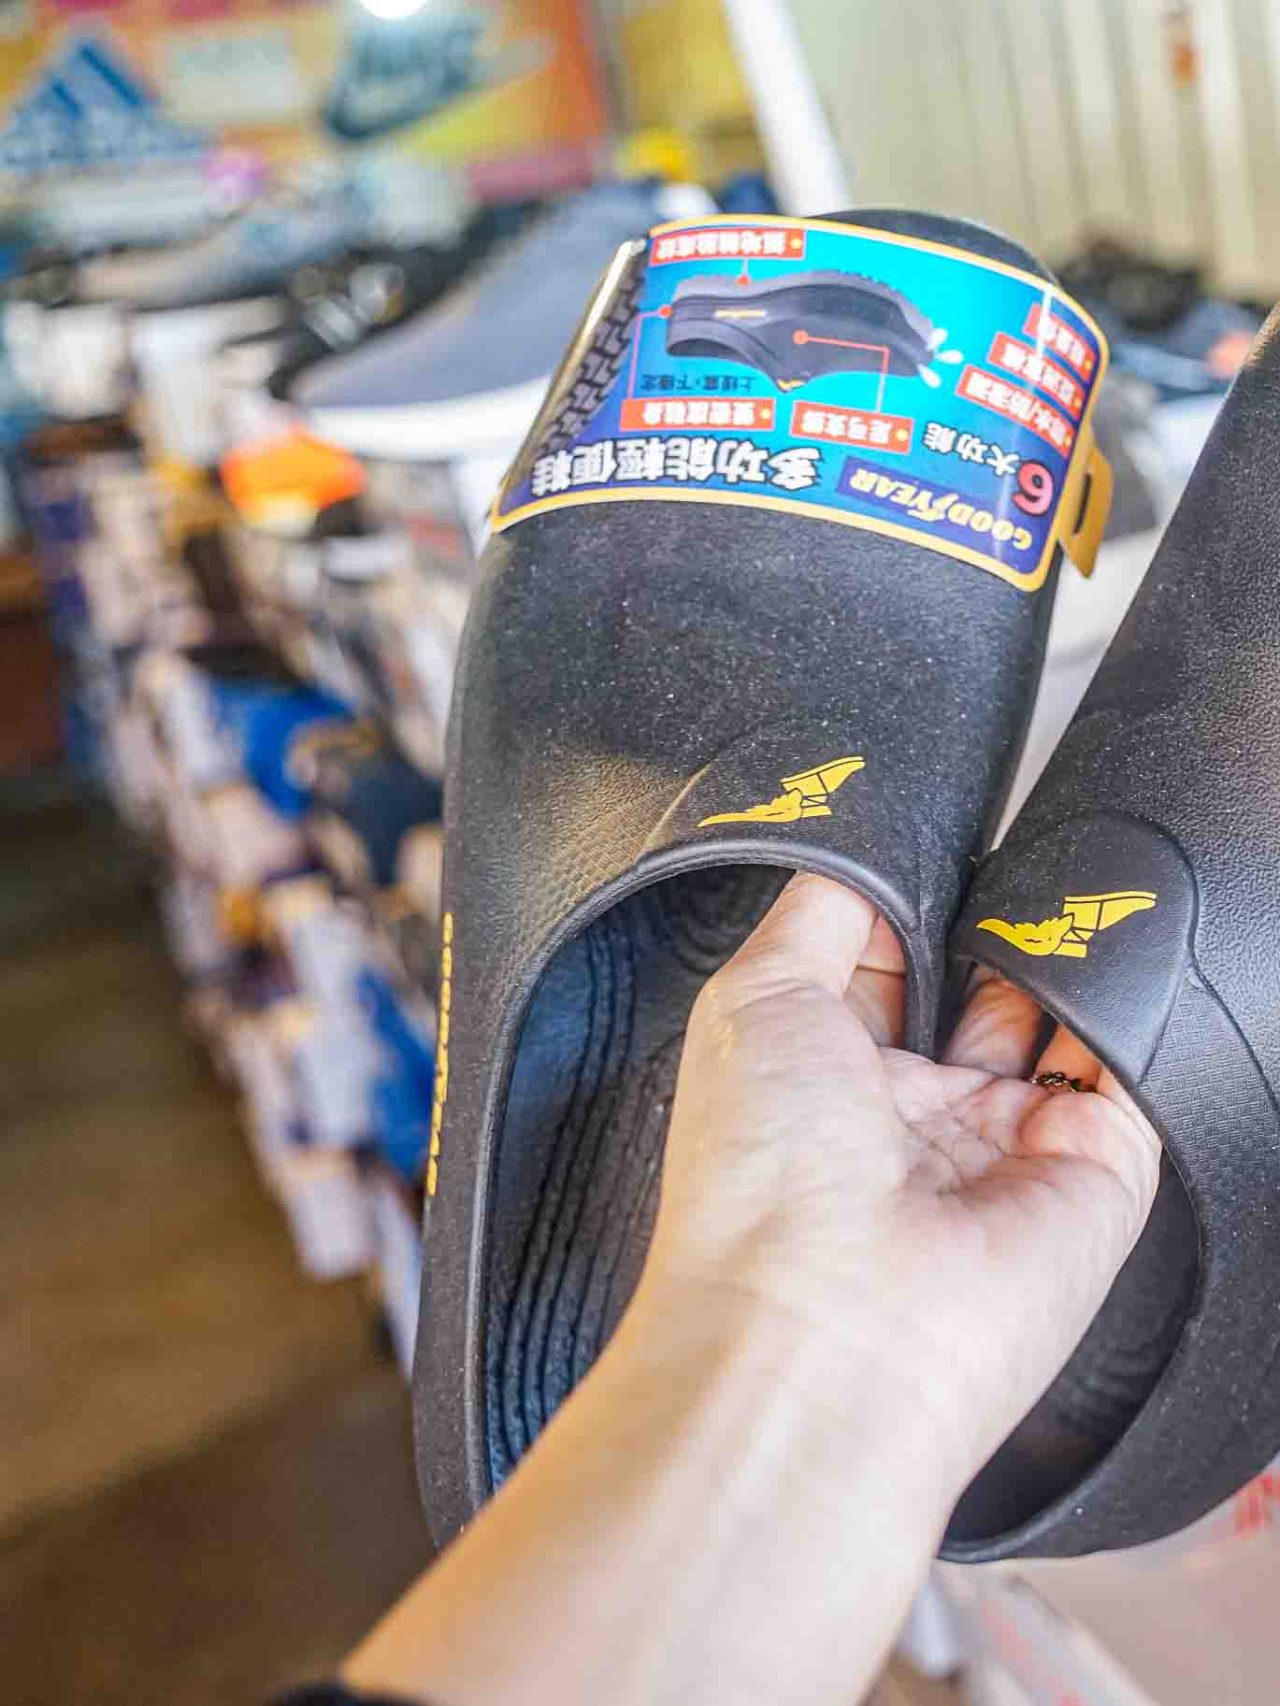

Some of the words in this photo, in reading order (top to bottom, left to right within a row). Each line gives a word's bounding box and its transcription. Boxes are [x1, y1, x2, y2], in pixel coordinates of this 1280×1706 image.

[532, 438, 821, 493] 多功能輕便鞋
[850, 467, 1034, 551] GOODYEAR
